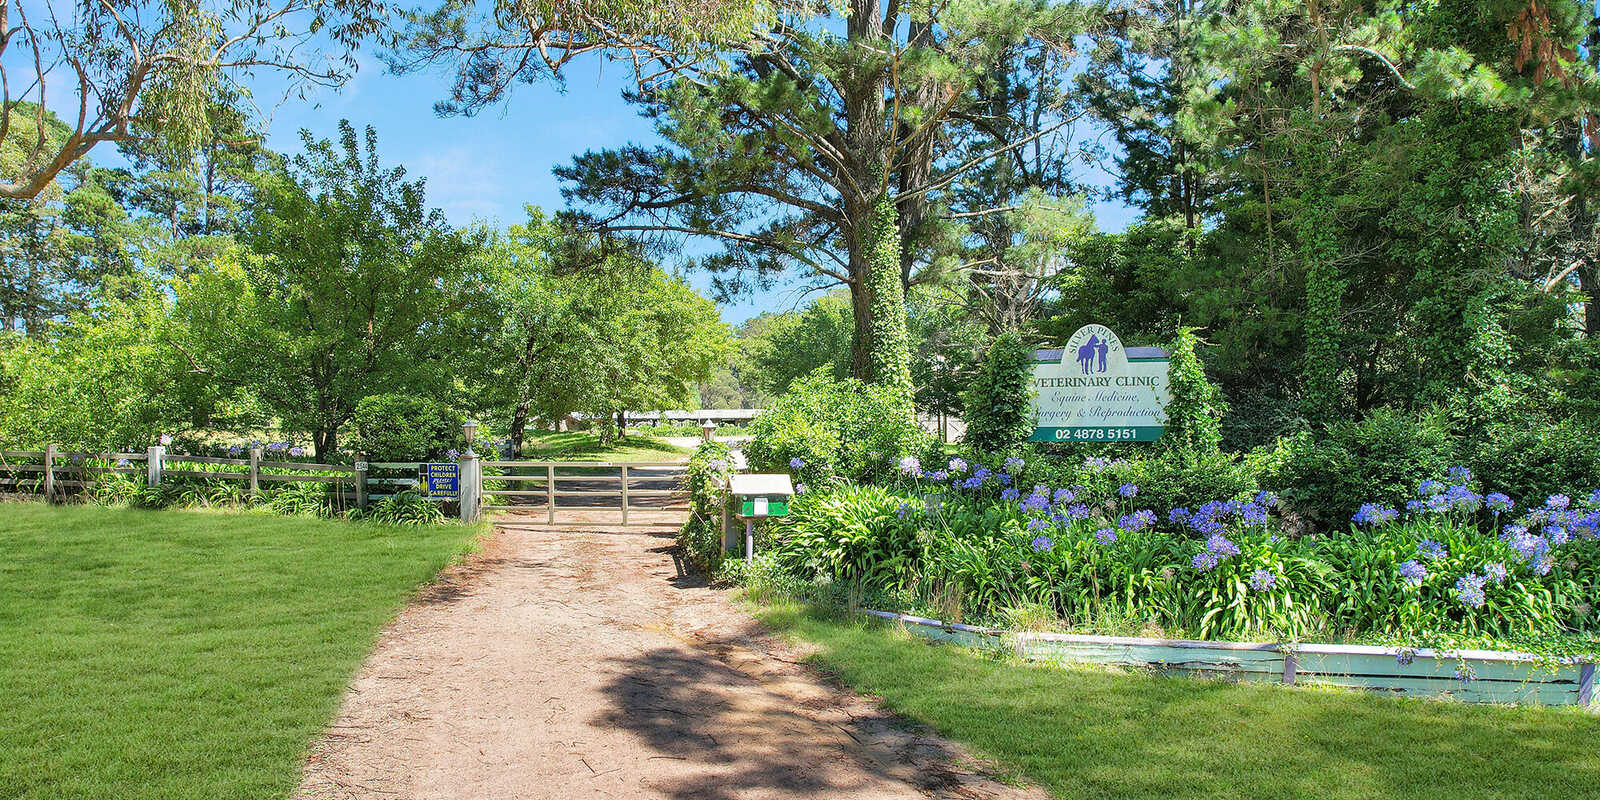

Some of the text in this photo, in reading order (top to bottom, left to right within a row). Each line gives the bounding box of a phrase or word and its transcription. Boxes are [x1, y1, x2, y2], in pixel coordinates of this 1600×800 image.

[1069, 326, 1120, 354] SILVER PINES
[1115, 376, 1160, 387] CLINIC
[1051, 390, 1140, 407] Equine Medicine,
[1036, 405, 1161, 421] urgery & Reproduction
[1055, 428, 1137, 439] 02 4878 5151
